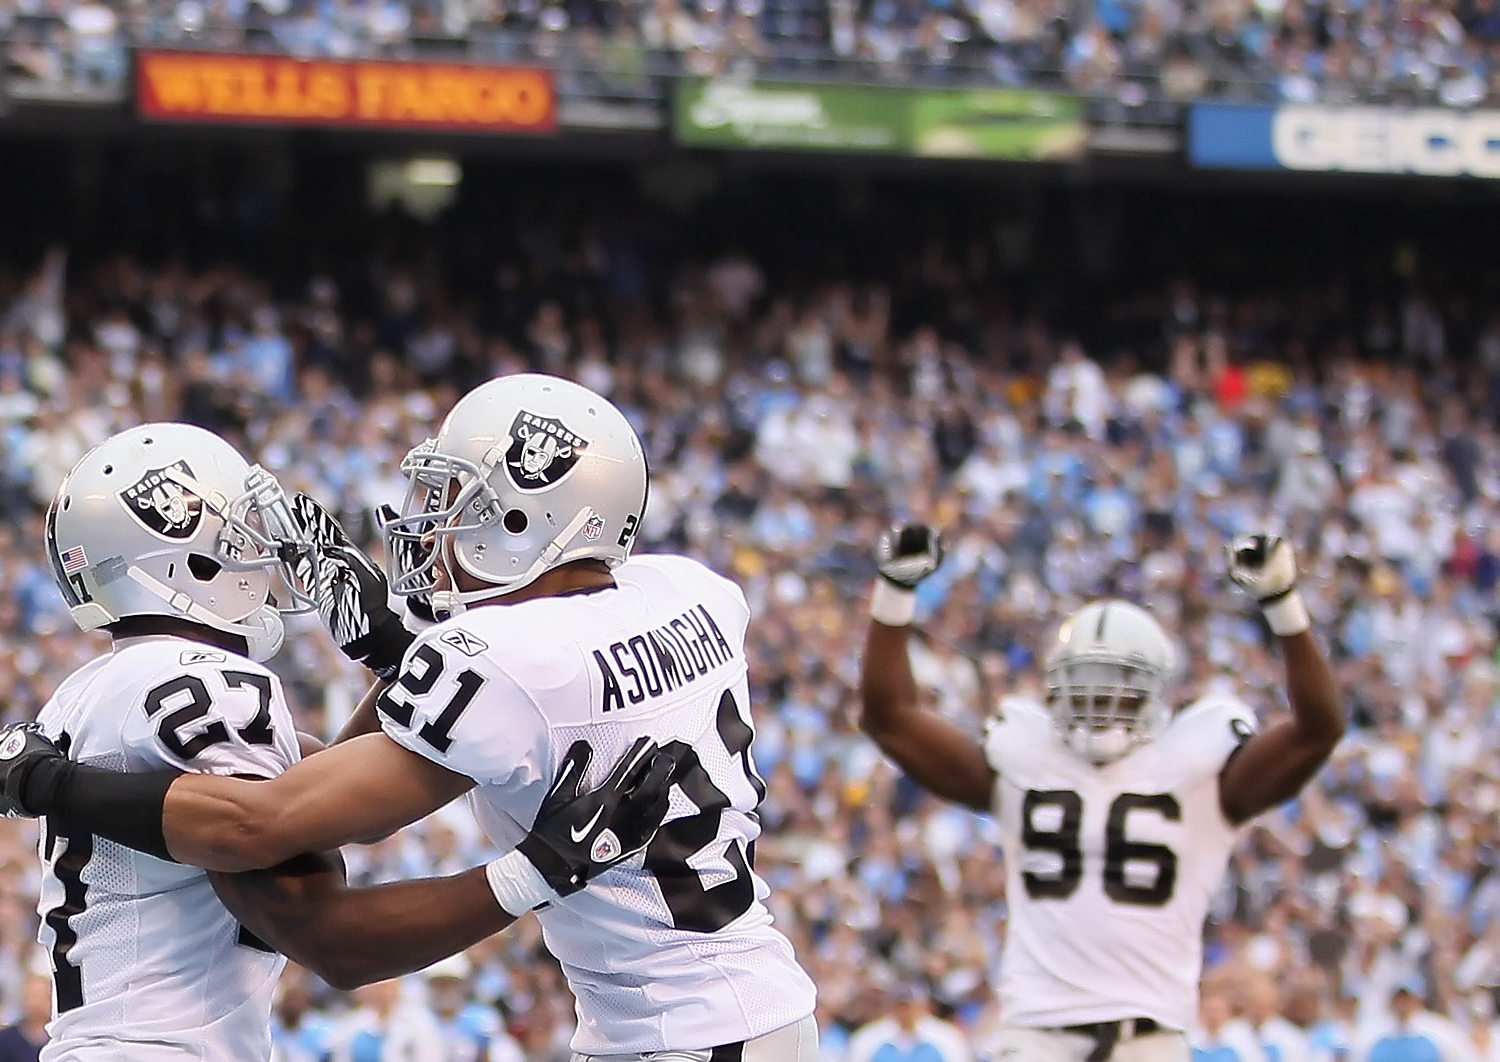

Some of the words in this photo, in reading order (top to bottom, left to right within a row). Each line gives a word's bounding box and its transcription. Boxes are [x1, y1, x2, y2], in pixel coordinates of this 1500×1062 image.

[145, 52, 350, 119] WELLS
[354, 61, 553, 126] FARGO
[522, 413, 583, 447] RAIDERS
[143, 670, 276, 760] 27
[376, 643, 488, 755] 21
[1020, 788, 1182, 908] 96
